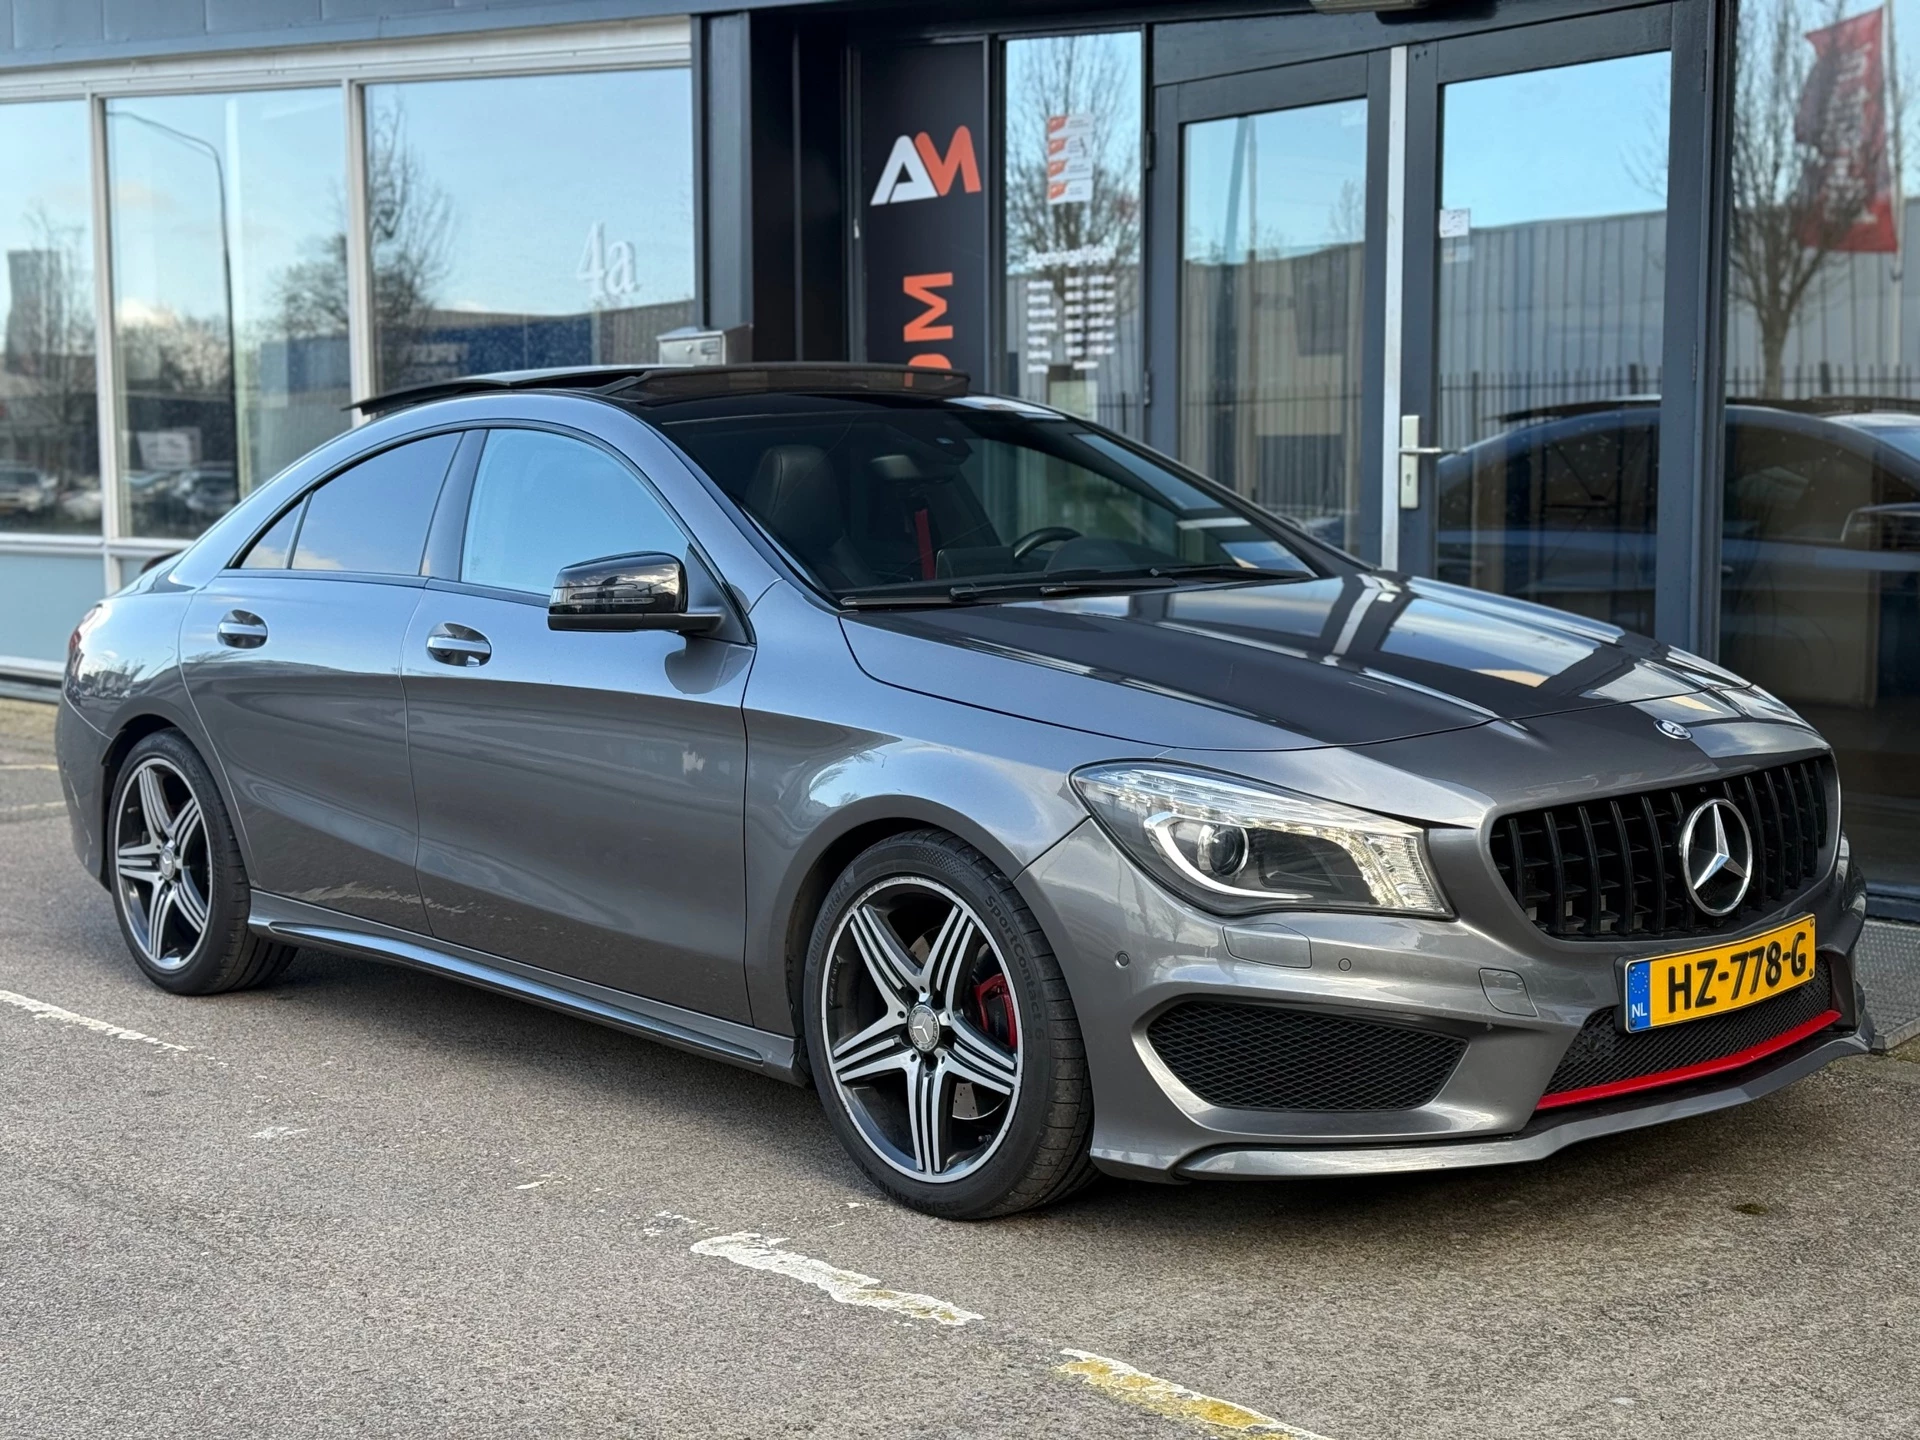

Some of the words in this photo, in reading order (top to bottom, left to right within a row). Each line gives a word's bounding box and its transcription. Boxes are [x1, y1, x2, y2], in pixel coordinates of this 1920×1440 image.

[870, 125, 982, 206] AM
[577, 221, 637, 296] 4a
[984, 894, 1043, 1022] SportContact
[1667, 931, 1807, 1014] HZ-778-G
[1631, 1001, 1648, 1018] NL
